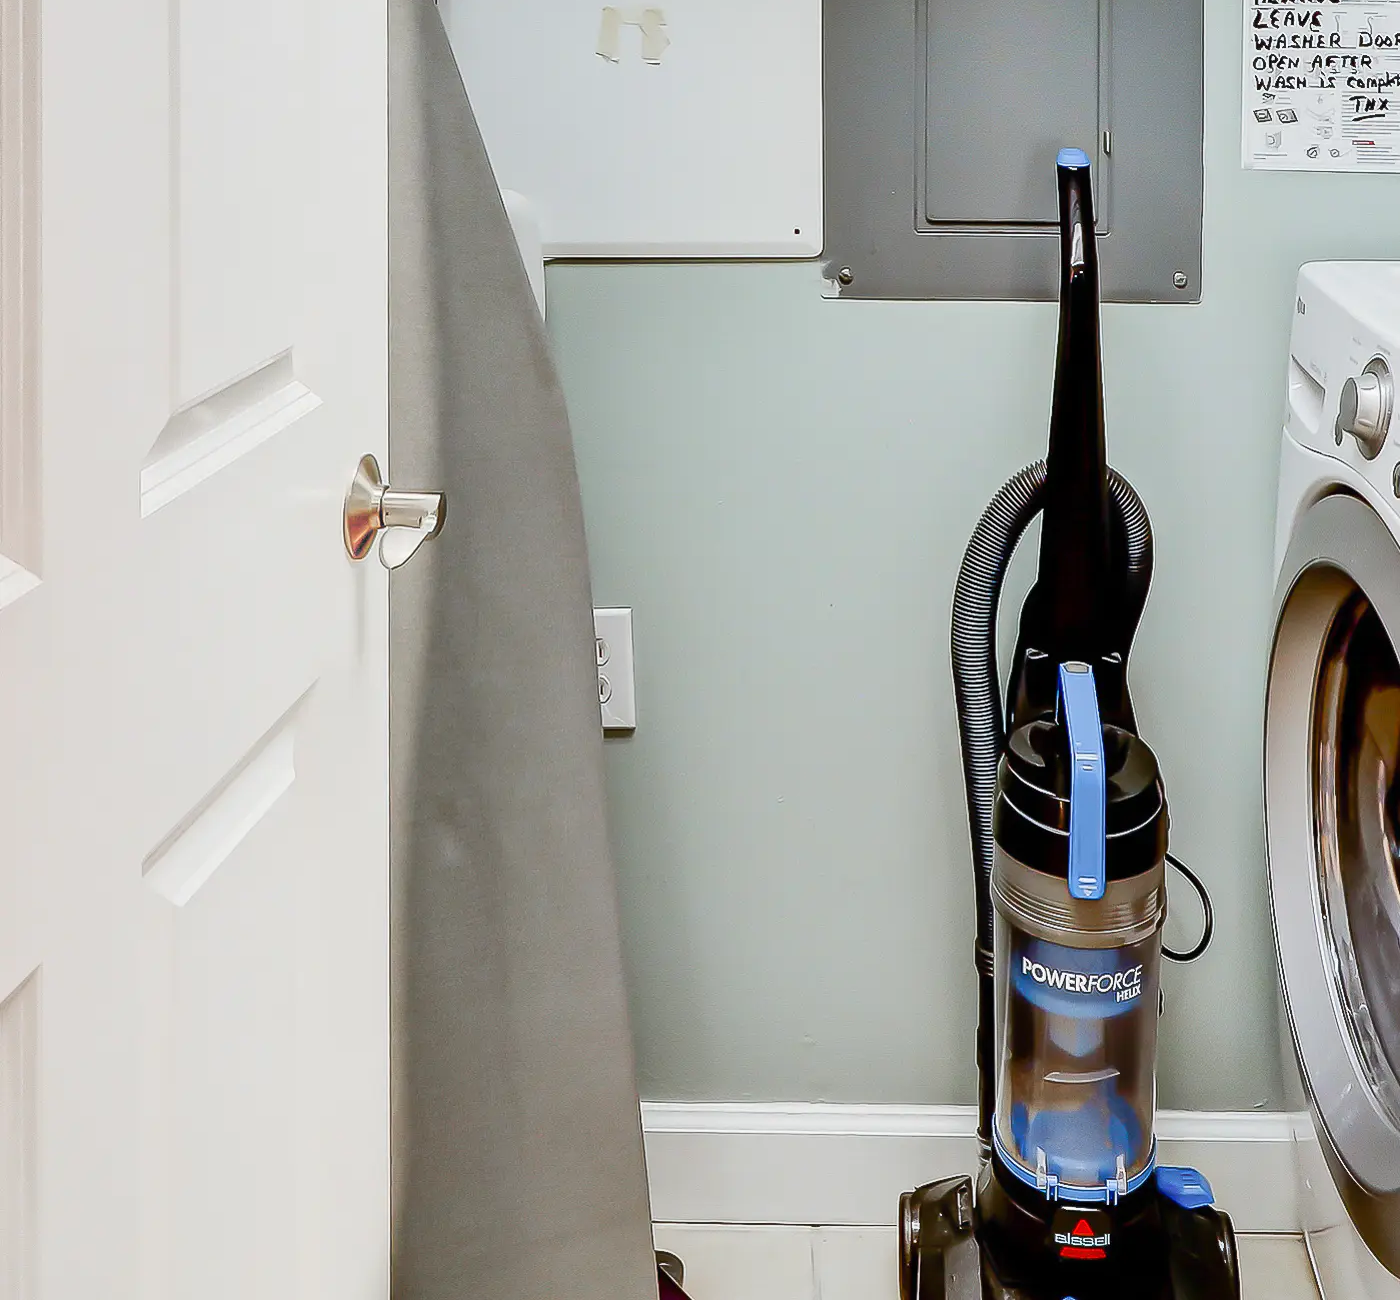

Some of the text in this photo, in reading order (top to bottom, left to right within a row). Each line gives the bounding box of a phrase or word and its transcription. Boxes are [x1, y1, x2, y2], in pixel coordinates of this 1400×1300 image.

[1252, 8, 1323, 32] LEAVE
[1254, 33, 1341, 50] WASHER
[1253, 54, 1372, 70] OPEN AFTER
[1255, 75, 1307, 91] WASH
[1021, 956, 1143, 993] POWERFORCE
[1116, 984, 1141, 1002] HELIX
